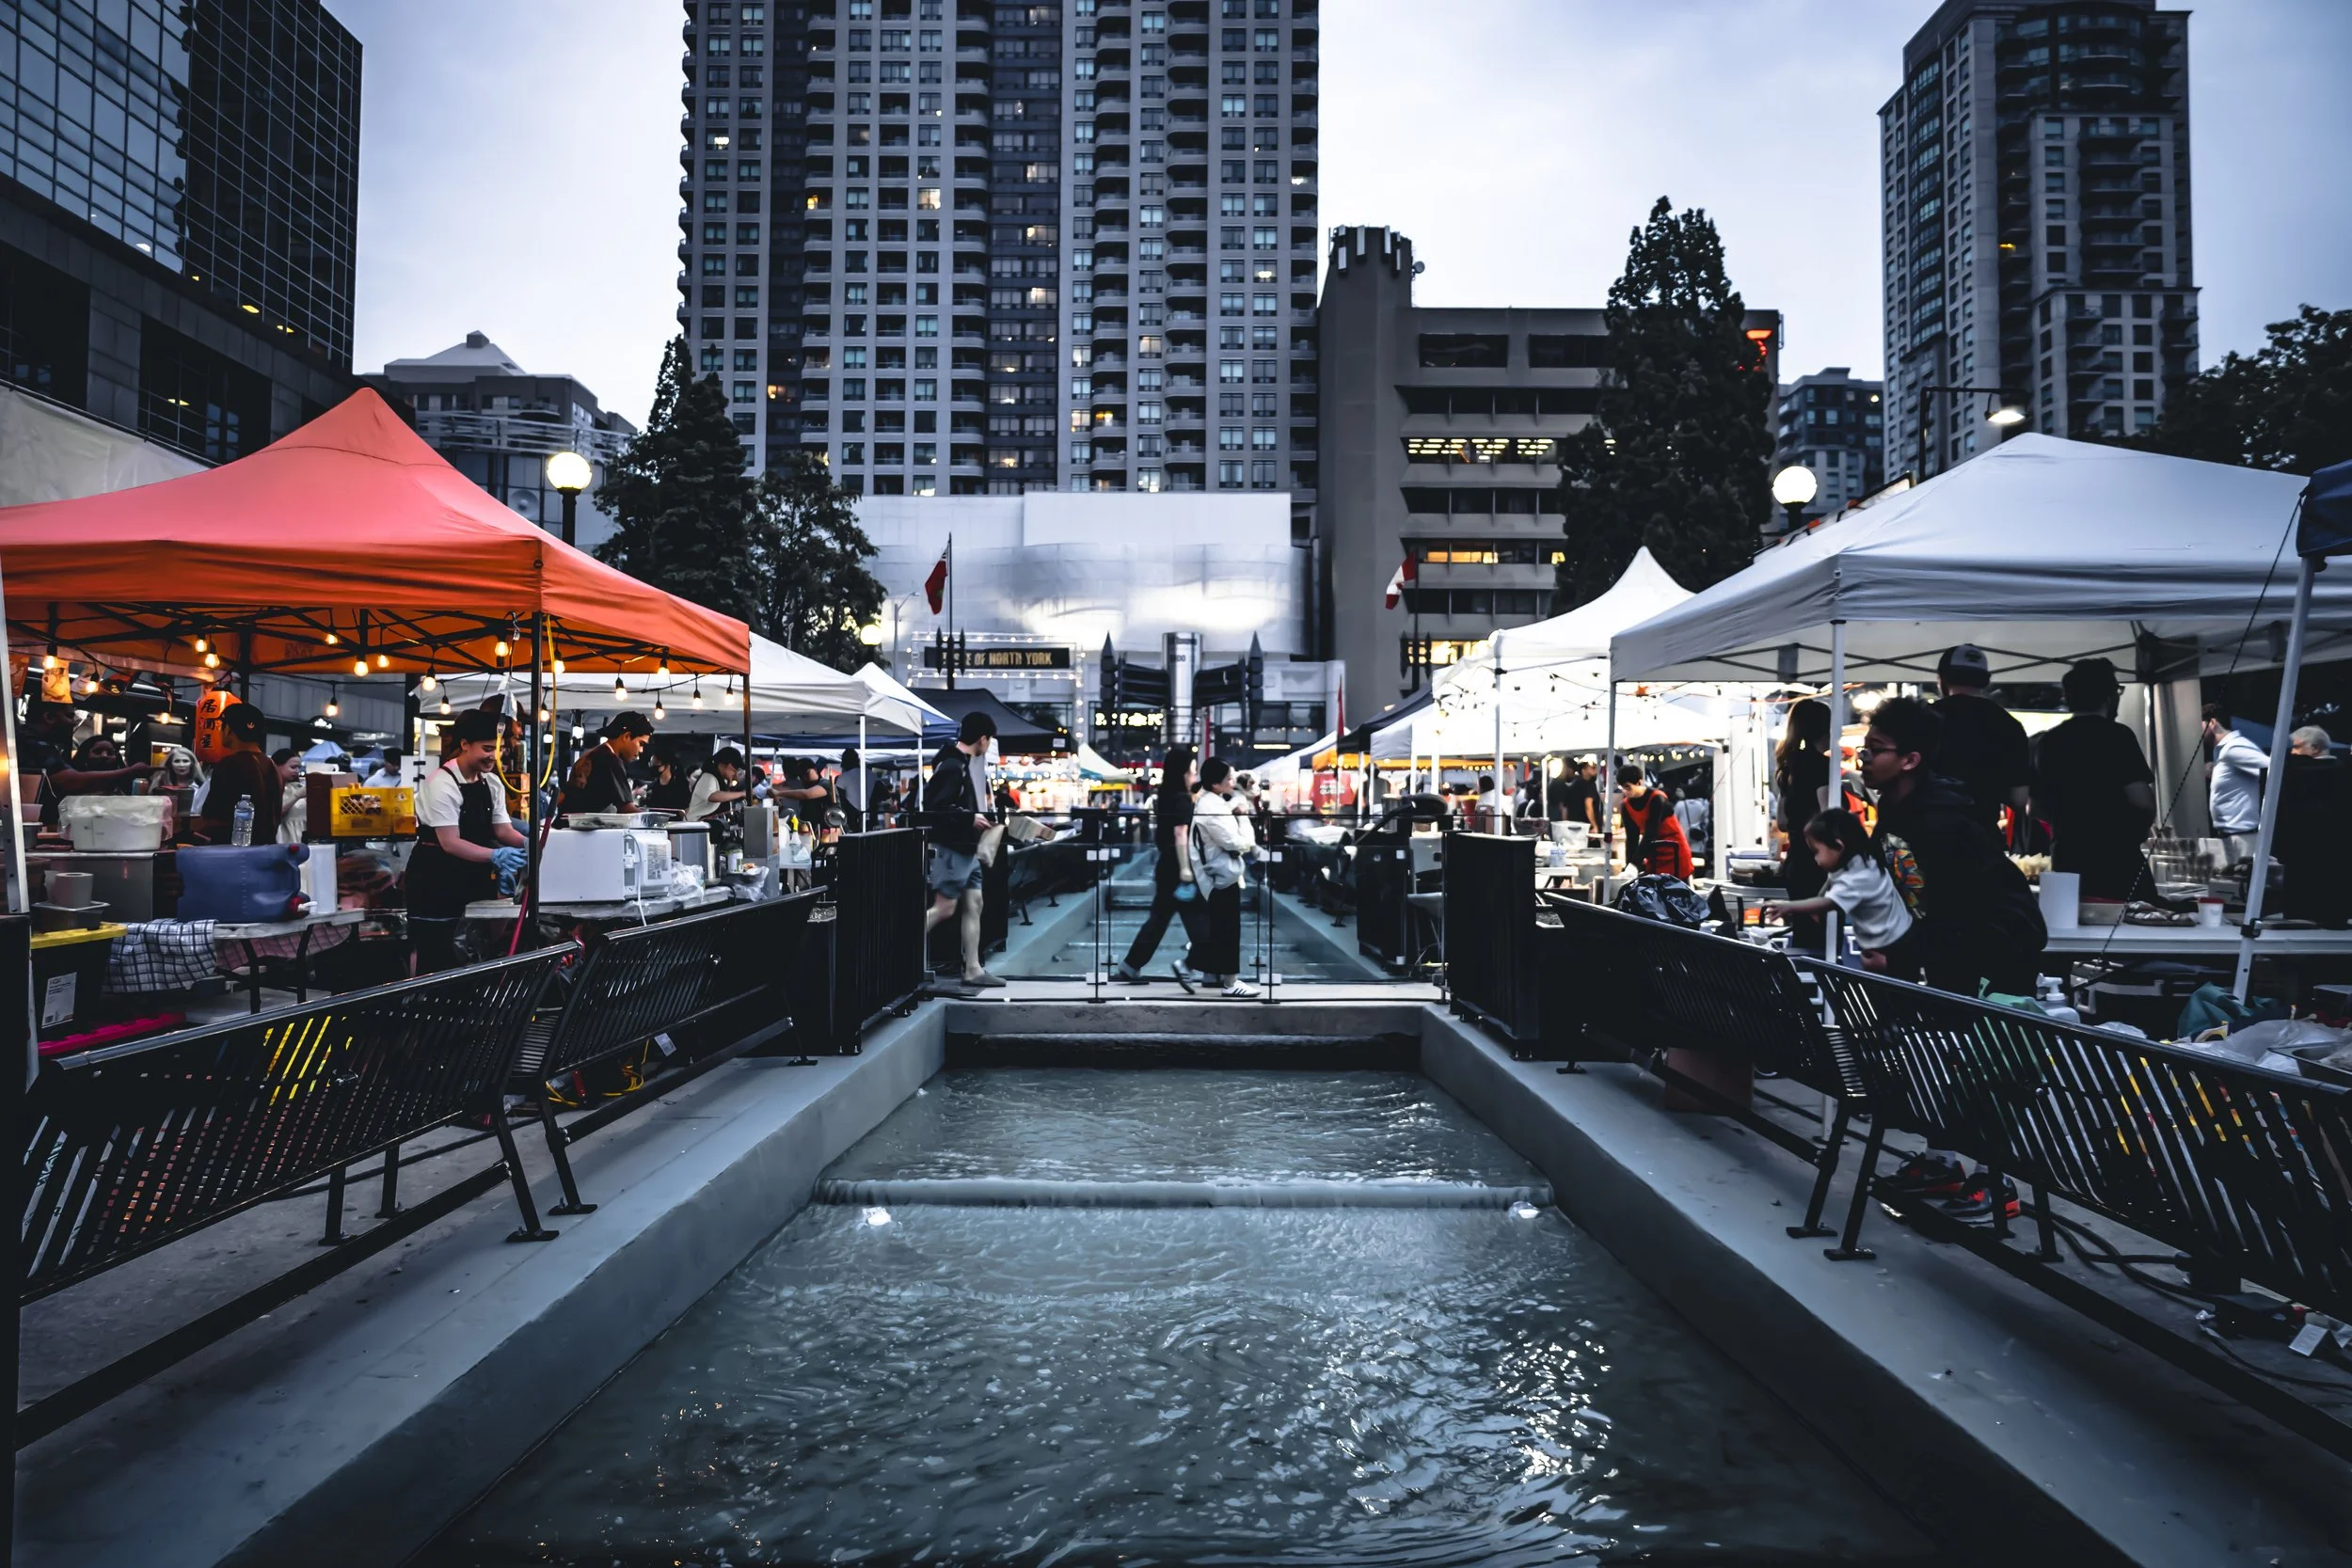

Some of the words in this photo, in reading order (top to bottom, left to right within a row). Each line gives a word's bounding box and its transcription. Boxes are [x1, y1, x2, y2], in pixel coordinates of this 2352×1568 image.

[974, 653, 986, 665] OF
[989, 652, 1023, 666] NORTH
[1025, 652, 1053, 666] YORK
